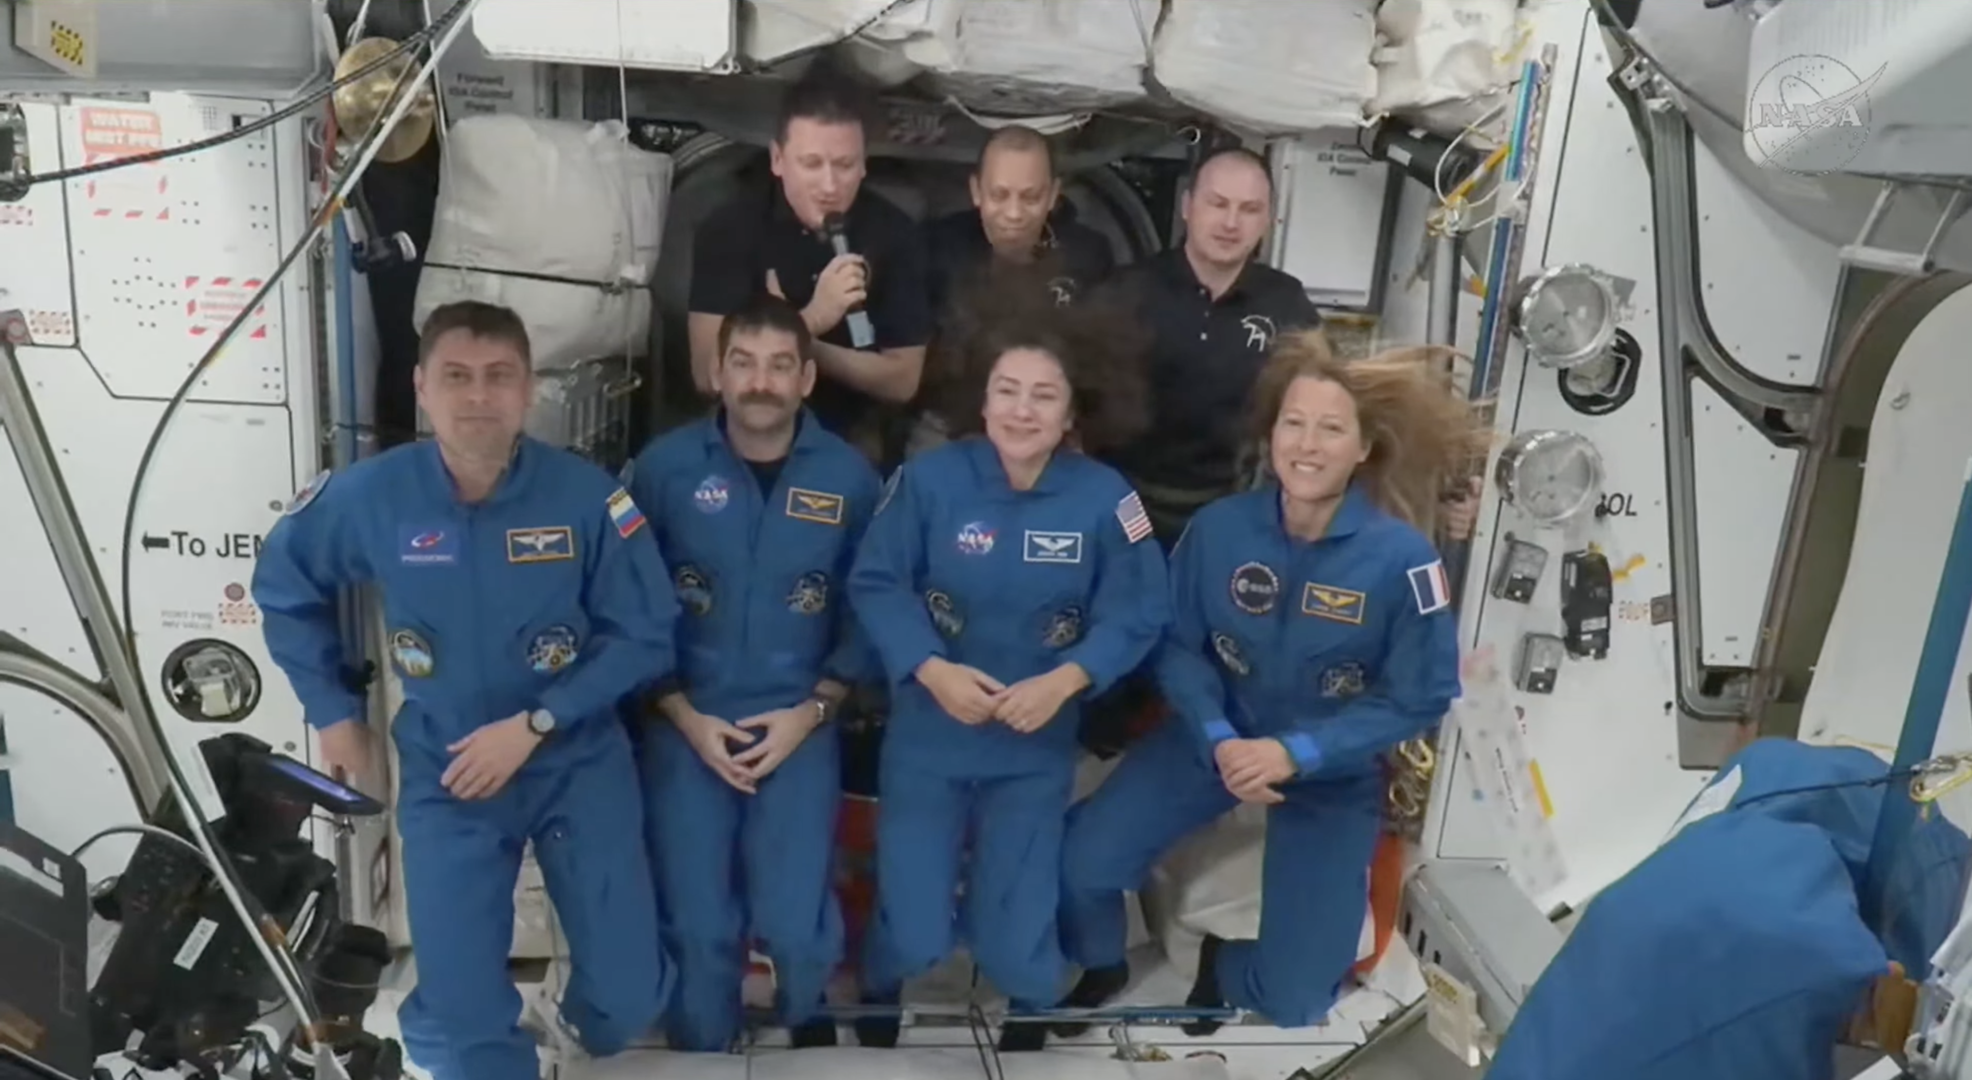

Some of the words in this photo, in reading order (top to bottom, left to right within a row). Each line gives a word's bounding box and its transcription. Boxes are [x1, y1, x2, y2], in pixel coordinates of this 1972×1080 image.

[694, 488, 729, 502] NASA
[1602, 492, 1637, 516] OL
[171, 530, 206, 557] To
[957, 531, 994, 546] NASA
